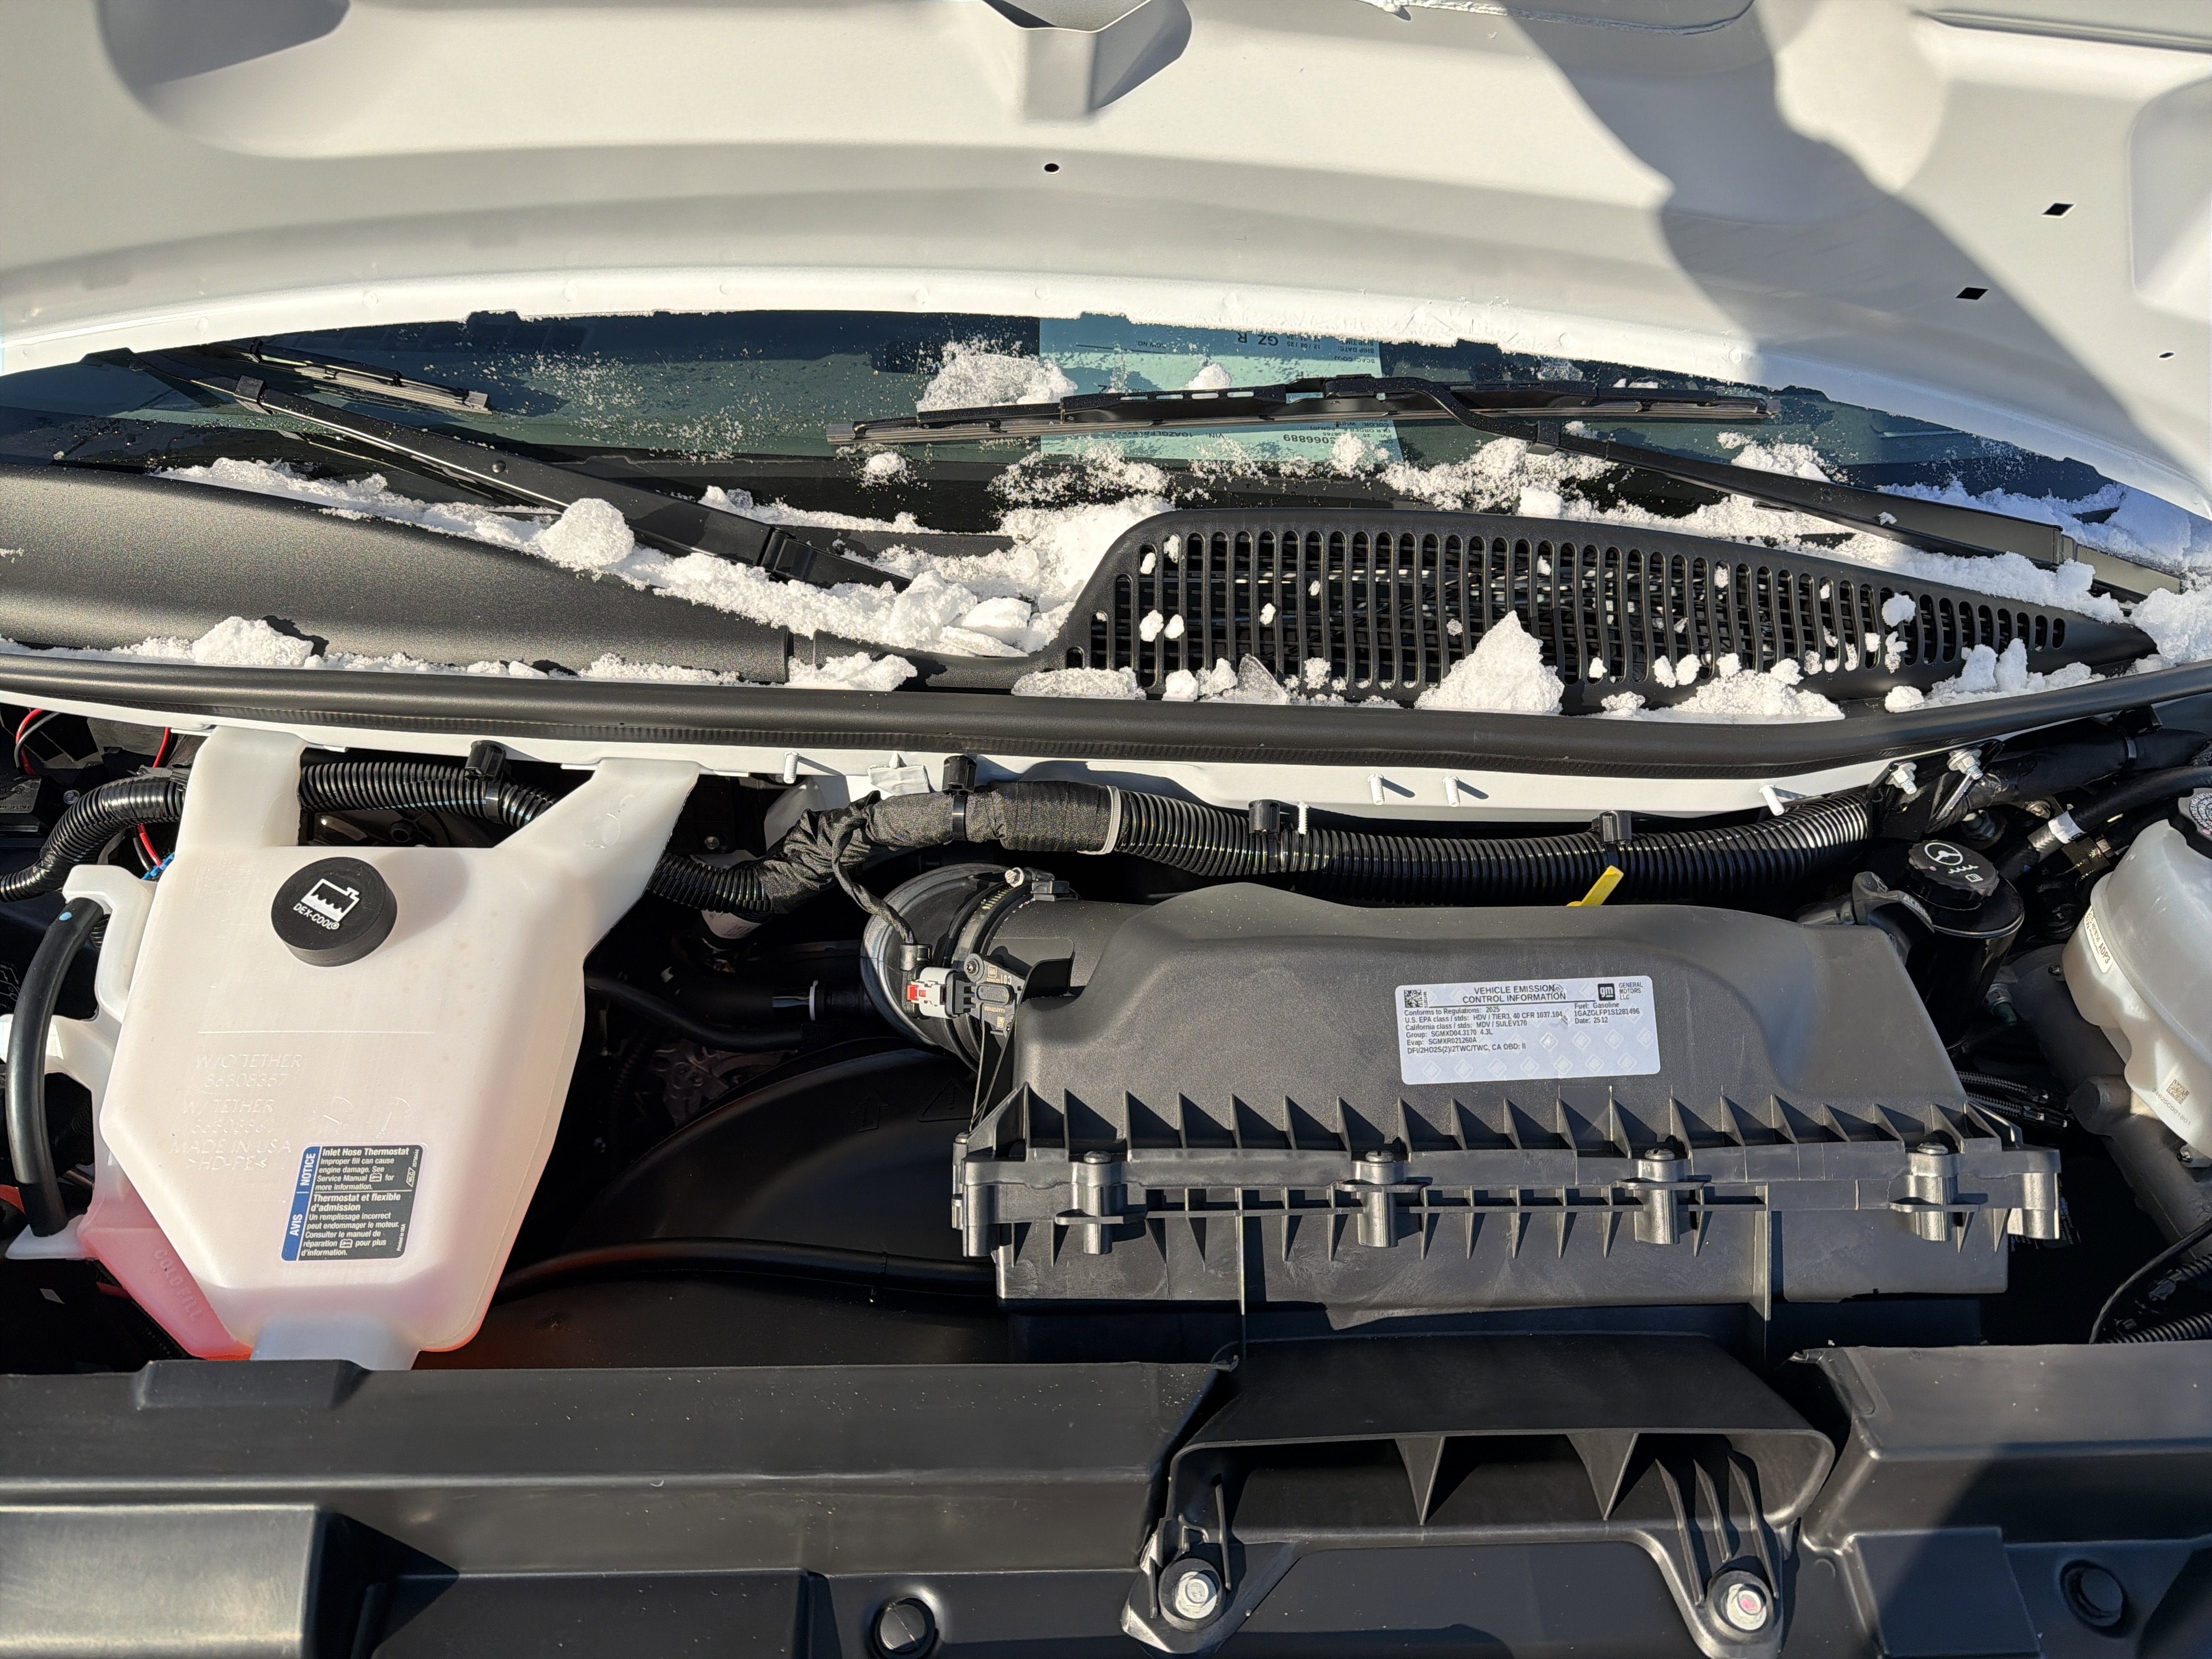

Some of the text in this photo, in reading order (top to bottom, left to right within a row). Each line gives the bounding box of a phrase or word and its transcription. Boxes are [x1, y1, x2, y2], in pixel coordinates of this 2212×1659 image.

[1237, 332, 1278, 346] GZ R
[1474, 985, 1555, 995] VEHICLE EMISSION
[1463, 994, 1566, 1003] CONTROL INFORMATION
[1443, 1008, 1481, 1016] Regulations:
[239, 1054, 303, 1068] TETHER
[214, 1099, 274, 1113] TETHER
[168, 1139, 291, 1154] MADE IN USA
[300, 1153, 316, 1186] NOTICE
[319, 1166, 340, 1175] engine
[342, 1166, 370, 1174] damage.
[313, 1194, 359, 1202] Thermostat
[311, 1203, 360, 1211] d'admission
[319, 1213, 359, 1221] remplissage
[289, 1214, 302, 1236] AVIS
[307, 1222, 321, 1231] peut
[323, 1222, 366, 1230] endommager
[303, 1239, 337, 1248] réparation
[155, 1249, 183, 1286] COLD
